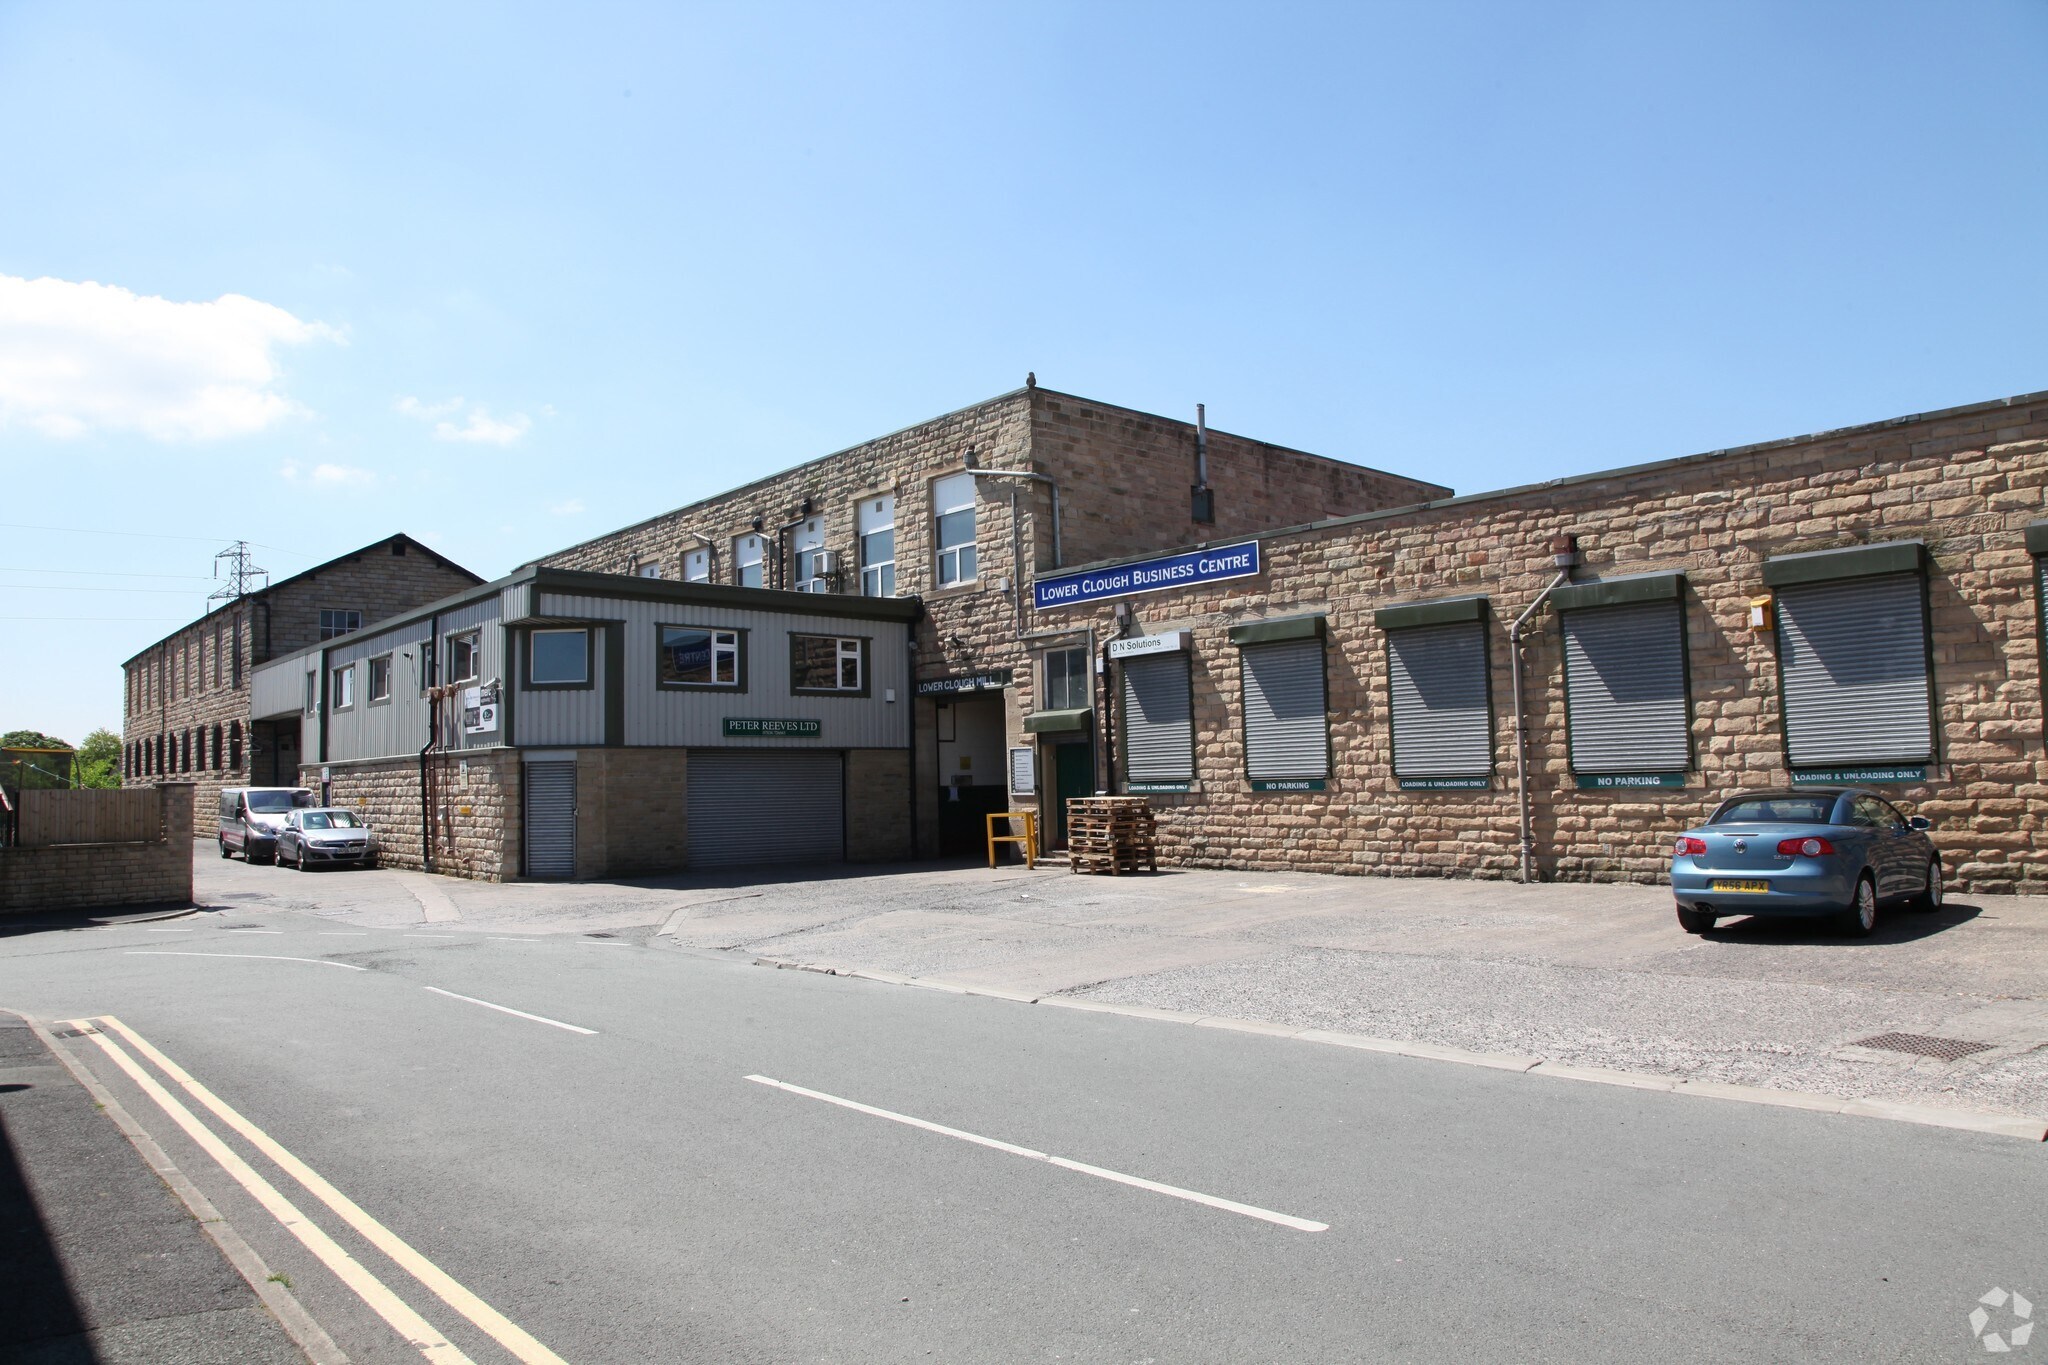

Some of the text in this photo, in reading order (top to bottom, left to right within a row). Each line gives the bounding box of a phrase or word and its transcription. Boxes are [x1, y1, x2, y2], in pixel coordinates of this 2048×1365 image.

[1041, 553, 1250, 601] LOWER CLOUGH BUSINESS CENTRE
[1112, 643, 1118, 652] D
[1119, 642, 1125, 651] N
[1126, 639, 1161, 650] Solutions
[918, 675, 993, 693] LOWER CLOUGH MILL
[729, 720, 818, 731] PETER REEVES LTD
[1597, 776, 1660, 786] NO PARKING
[1795, 773, 1832, 781] LOADING
[1843, 771, 1895, 780] UNLOADING
[1896, 770, 1921, 778] ONLY
[1266, 782, 1309, 790] NO PARKING
[1717, 880, 1765, 891] YR56 APX
